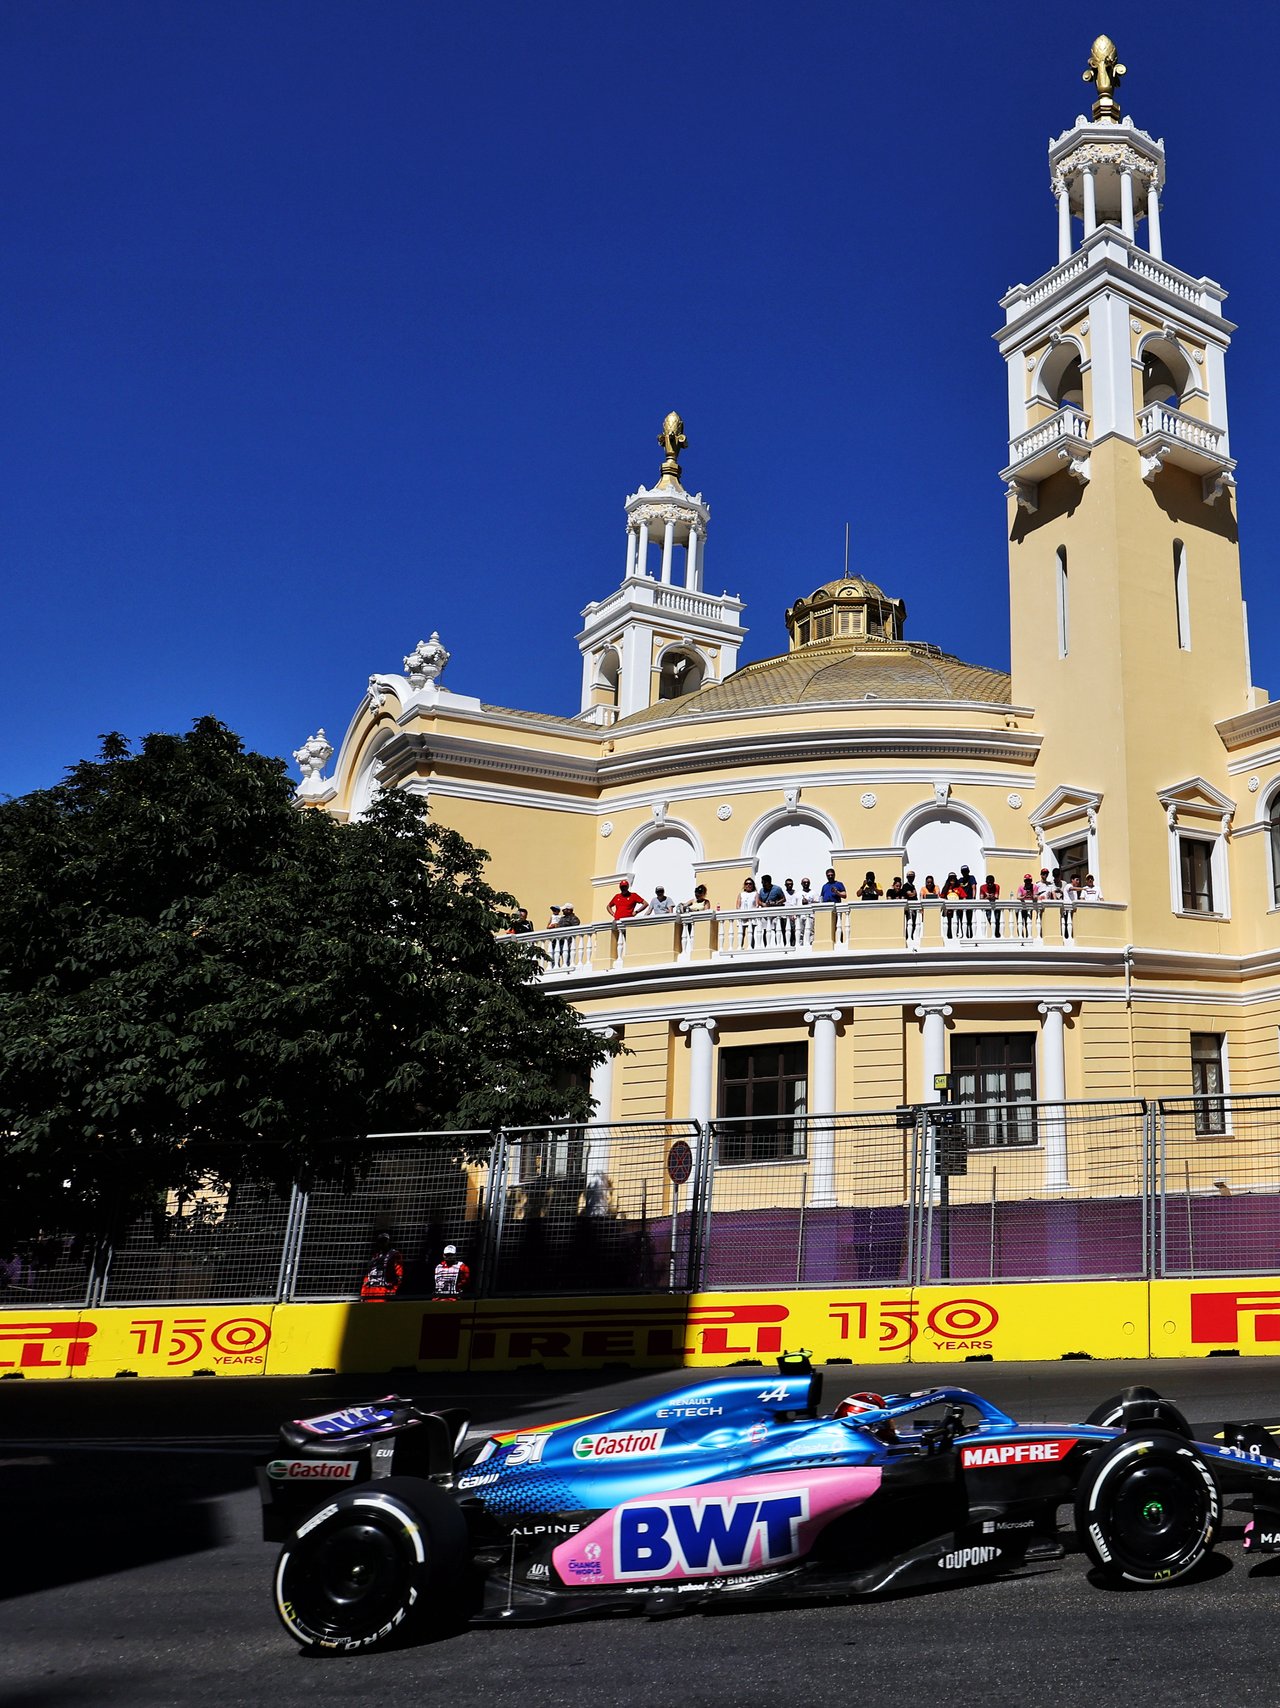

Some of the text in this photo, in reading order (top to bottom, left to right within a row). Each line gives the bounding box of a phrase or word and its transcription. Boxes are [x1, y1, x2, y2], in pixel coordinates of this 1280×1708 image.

[419, 1304, 789, 1359] PIRELLI
[829, 1299, 998, 1351] 150
[130, 1318, 271, 1365] 150
[933, 1340, 993, 1350] YEARS
[213, 1355, 263, 1365] YEARS
[656, 1407, 723, 1418] E-TECH
[669, 1398, 713, 1406] RENAULT
[505, 1432, 553, 1466] 31
[595, 1433, 658, 1456] Castrol
[964, 1443, 1060, 1467] MAPFRE
[289, 1462, 351, 1478] Castrol
[1191, 1459, 1218, 1518] ZERO
[511, 1524, 580, 1535] ALPINE
[620, 1496, 802, 1573] BWT
[997, 1520, 1035, 1530] Microsoft
[946, 1546, 995, 1569] DUPONT
[529, 1564, 550, 1575] ADA
[345, 1607, 406, 1650] ZERO
